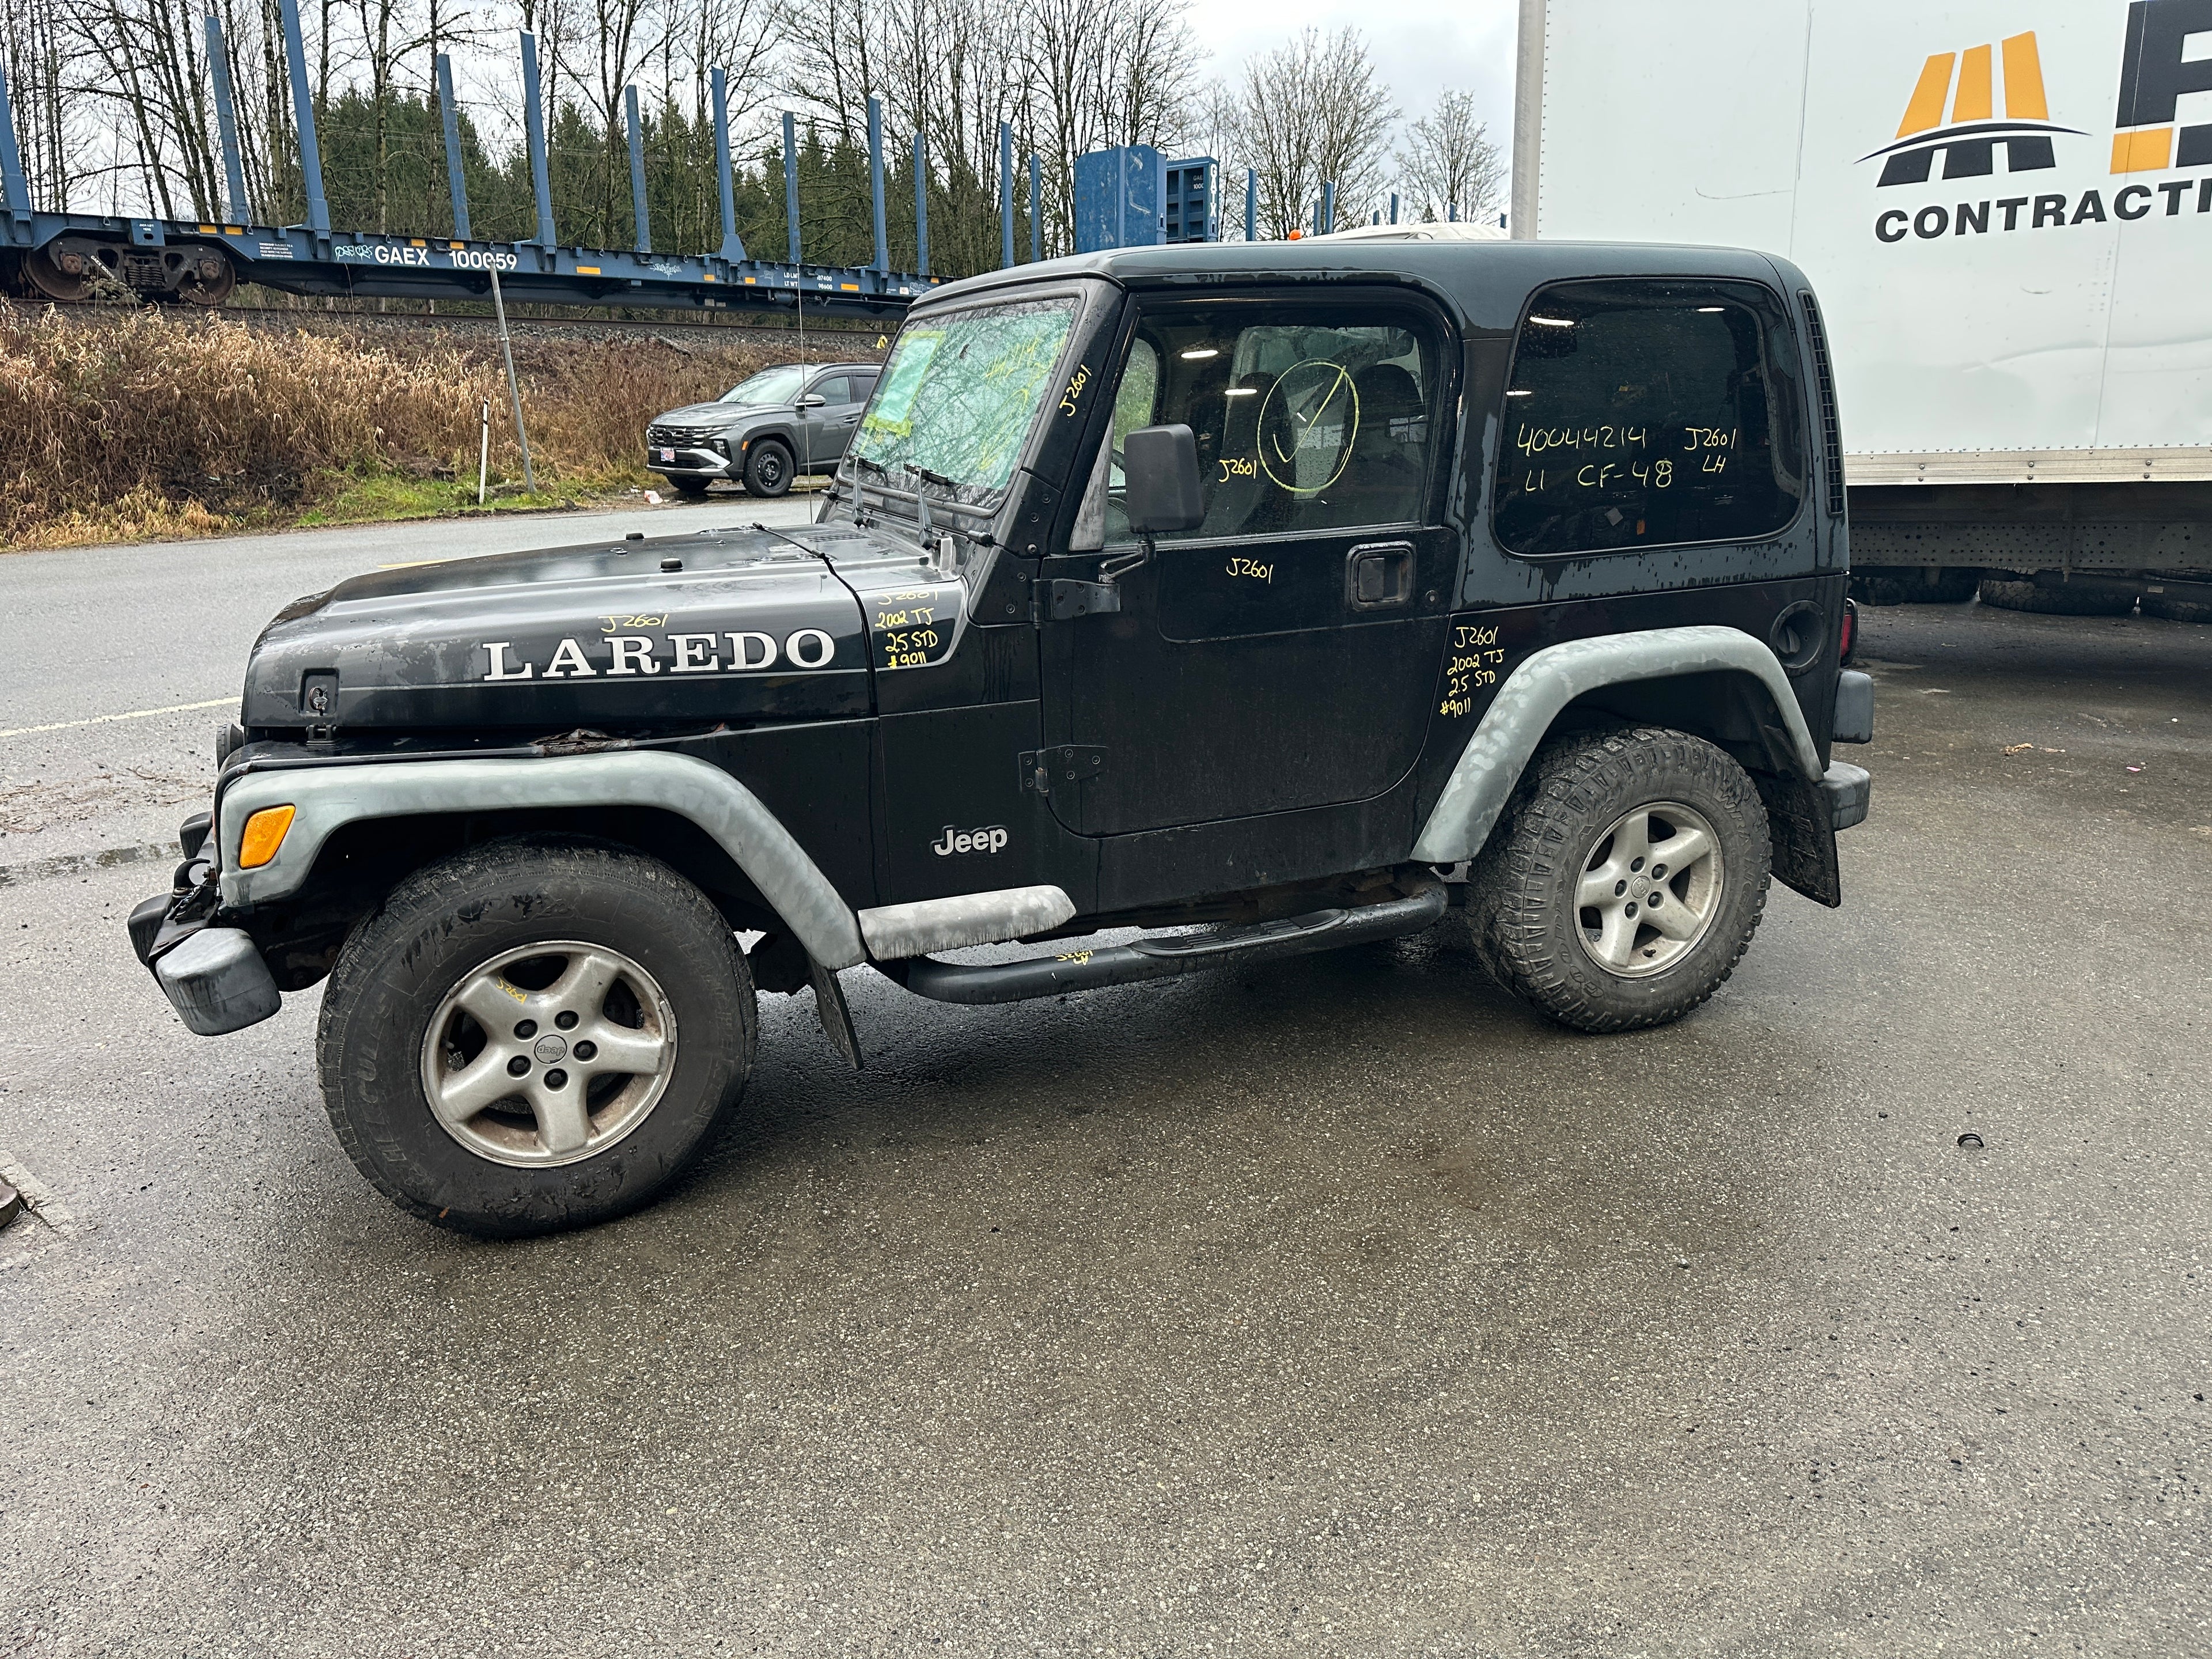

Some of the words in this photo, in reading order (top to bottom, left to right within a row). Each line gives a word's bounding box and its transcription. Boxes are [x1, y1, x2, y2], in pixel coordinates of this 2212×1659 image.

[374, 245, 430, 266] GAEX
[449, 251, 517, 270] 100059
[1059, 364, 1092, 416] J2601
[1684, 427, 1736, 450] J2601
[1218, 457, 1257, 483] J2601
[1703, 454, 1726, 474] LH
[1226, 557, 1274, 584] J2601
[597, 613, 668, 633] J2601
[874, 610, 909, 629] 2002
[910, 607, 934, 626] TJ
[911, 630, 938, 647] STD
[1454, 626, 1499, 649] J2601
[482, 629, 835, 681] LAREDO
[888, 651, 927, 669] #9011
[1447, 653, 1480, 676] 2002
[1483, 648, 1505, 663] TJ
[1448, 674, 1469, 697] 2.5
[1475, 670, 1496, 687] STD
[1440, 697, 1471, 718] #9011
[934, 828, 1007, 856] Jeep
[536, 1044, 565, 1056] Jeep
